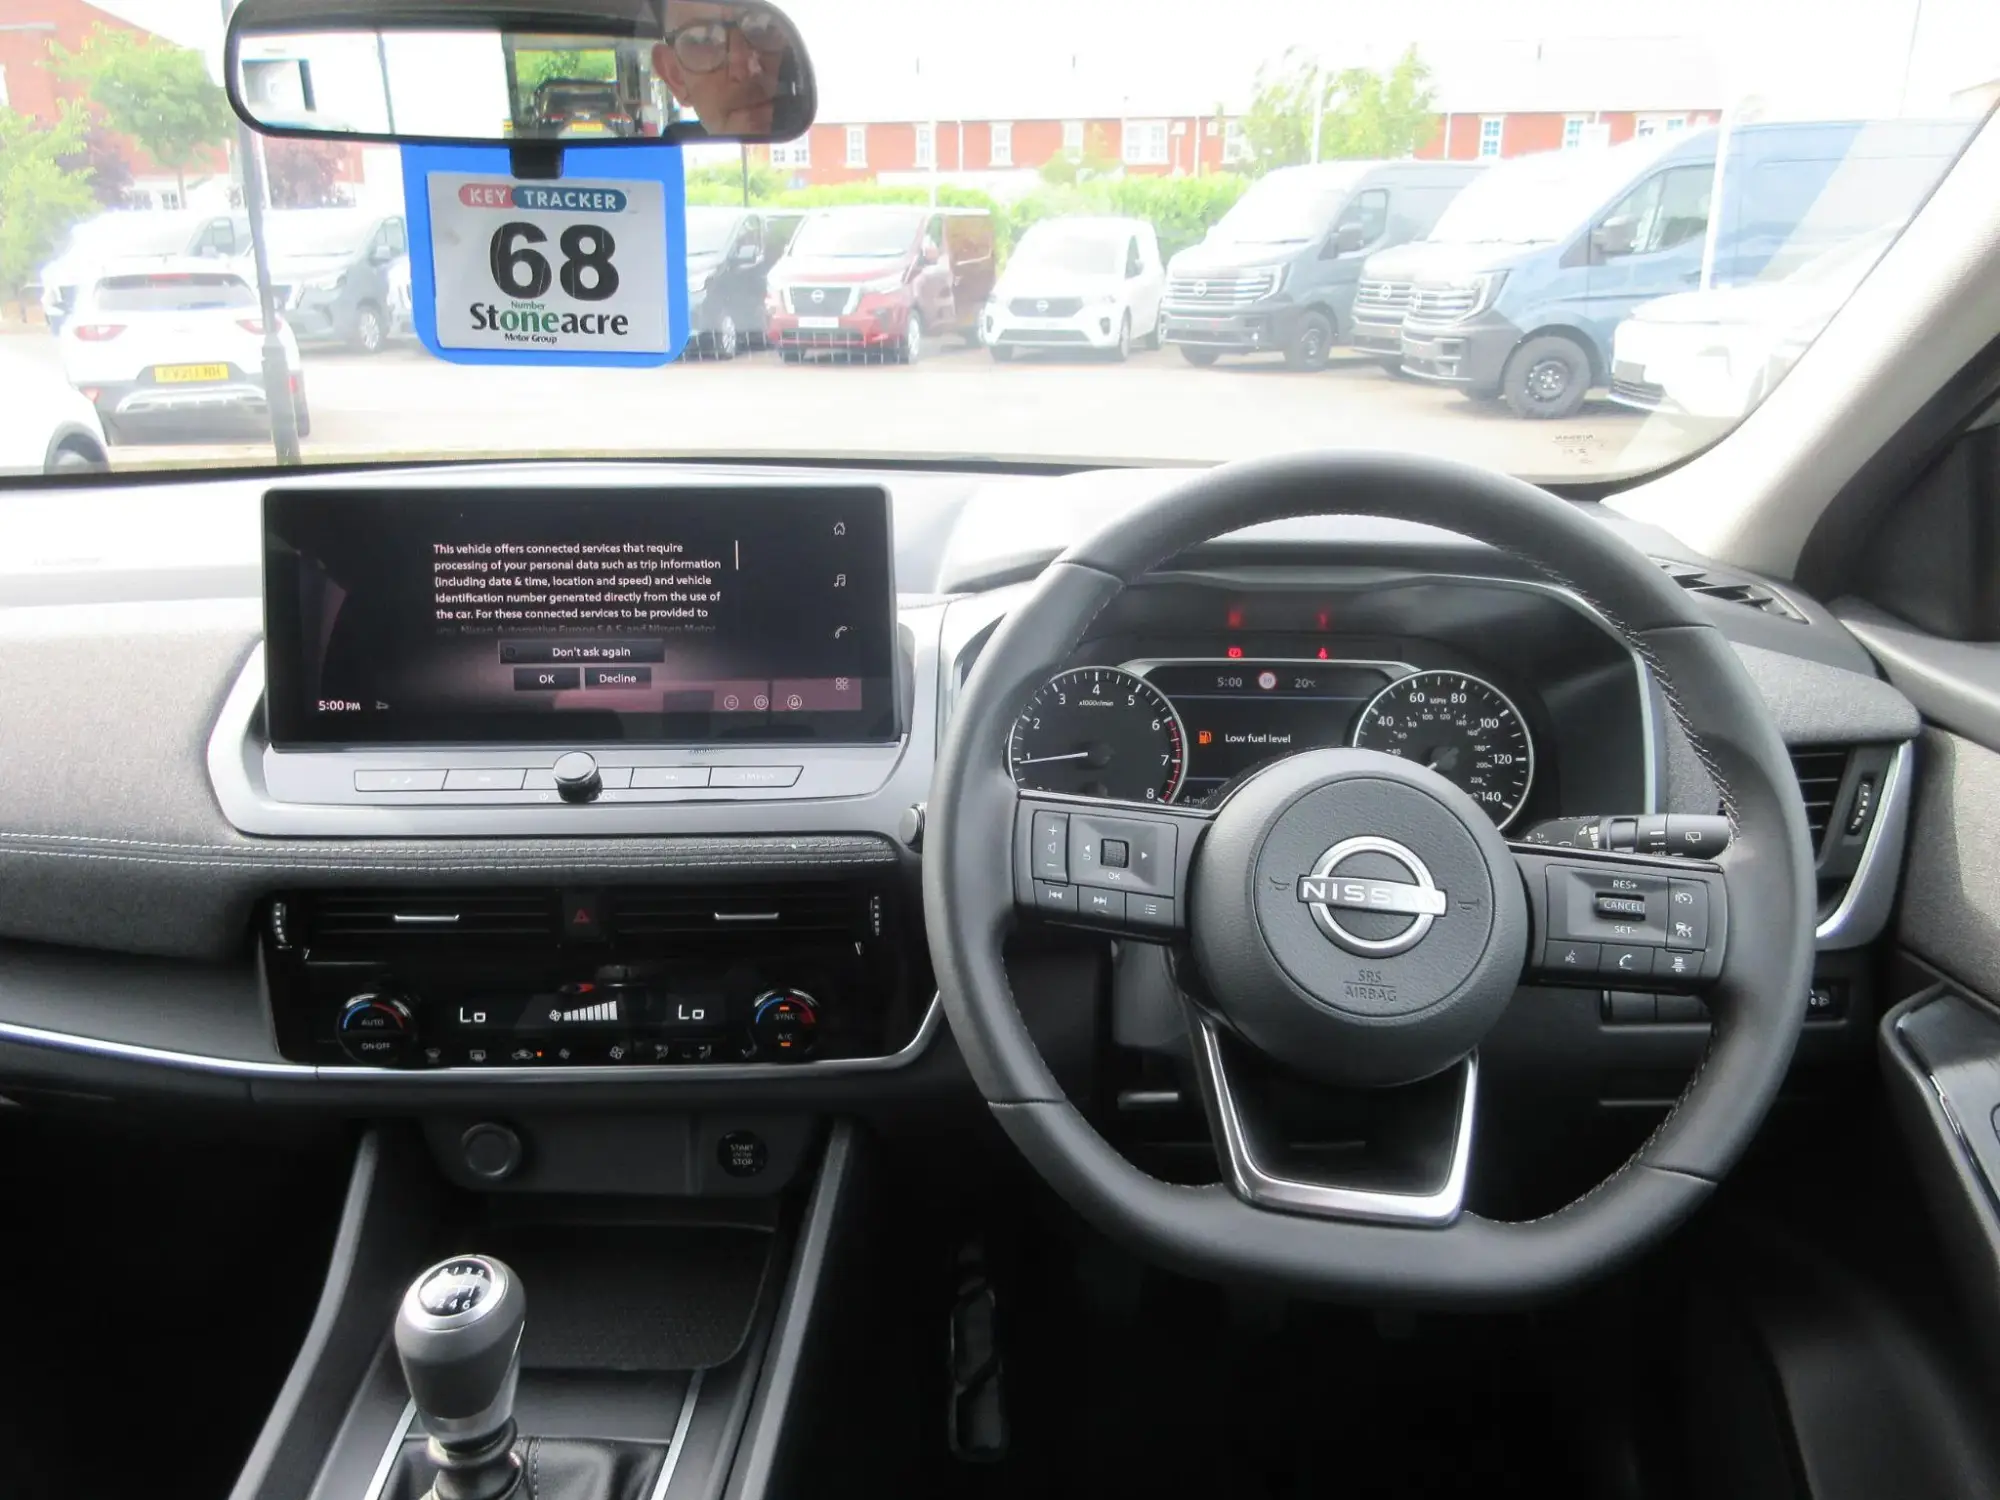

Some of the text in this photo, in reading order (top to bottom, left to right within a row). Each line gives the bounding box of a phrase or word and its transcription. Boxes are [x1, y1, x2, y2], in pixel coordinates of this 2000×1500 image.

[470, 187, 616, 210] KEY TRACKER
[490, 221, 620, 301] 68
[511, 301, 546, 311] Number
[469, 302, 629, 336] Stoneacre
[504, 333, 557, 345] Motor Group
[433, 543, 683, 555] This vehicle offers connected services that require
[434, 560, 488, 572] processing
[490, 560, 502, 570] of
[503, 562, 526, 572] your
[529, 560, 573, 571] personal
[576, 560, 599, 570] data
[601, 559, 625, 569] such
[640, 559, 657, 571] trip
[660, 559, 721, 569] information
[435, 575, 712, 588] (including date & time, location and speed) and vehicle
[435, 591, 721, 604] identification number generated directly from the use of
[436, 608, 708, 620] the car. For these connected services to be provided to
[552, 647, 631, 658] Don't ask again
[539, 674, 555, 684] OK
[599, 673, 637, 684] Decline
[1217, 676, 1243, 688] 5:00
[1092, 684, 1101, 695] 4
[1058, 694, 1066, 705] 3
[1127, 694, 1135, 705] 5
[1409, 692, 1425, 703] 60
[1429, 697, 1447, 705] MPH
[1451, 692, 1467, 704] 80
[318, 700, 361, 711] 5:00 PM
[1377, 716, 1394, 727] 40
[1422, 713, 1433, 721] 100
[1032, 718, 1041, 729] 2
[1151, 719, 1160, 731] 6
[1479, 718, 1499, 729] 100
[1225, 733, 1291, 744] Low fuel level
[1397, 732, 1408, 740] 60
[1160, 755, 1169, 766] 7
[1493, 754, 1512, 765] 120
[1470, 776, 1483, 784] 220
[1146, 788, 1154, 799] 8
[1481, 791, 1501, 802] 140
[1108, 871, 1121, 881] OK
[1603, 900, 1641, 912] CANCEL
[1358, 969, 1382, 983] SRS
[1345, 988, 1397, 1002] AIRBAG
[459, 1007, 486, 1023] Lo
[678, 1003, 705, 1020] Lo
[774, 1013, 796, 1021] SYNC
[361, 1018, 384, 1027] AUTO
[777, 1032, 792, 1040] A/C
[729, 1143, 754, 1151] START
[448, 1299, 458, 1310] 4
[462, 1299, 471, 1310] 6
